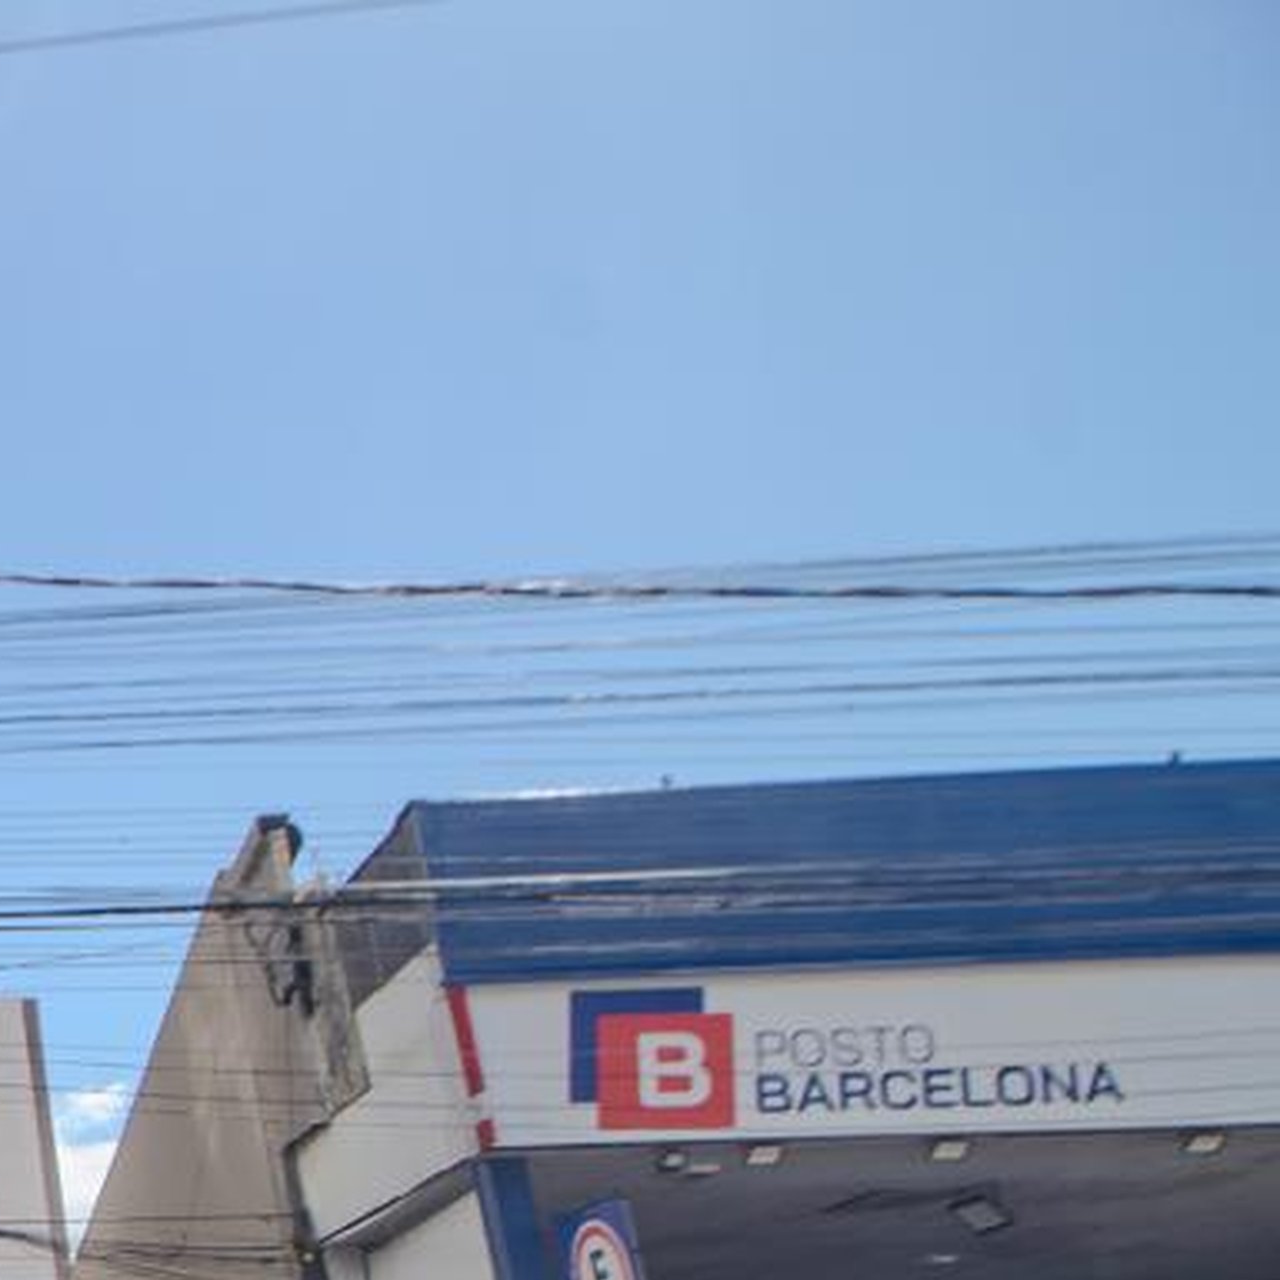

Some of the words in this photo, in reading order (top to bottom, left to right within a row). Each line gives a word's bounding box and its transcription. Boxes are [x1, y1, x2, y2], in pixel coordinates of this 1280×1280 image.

[635, 1030, 713, 1108] B
[754, 1024, 937, 1068] POSTO
[755, 1061, 1125, 1114] BARCELONA
